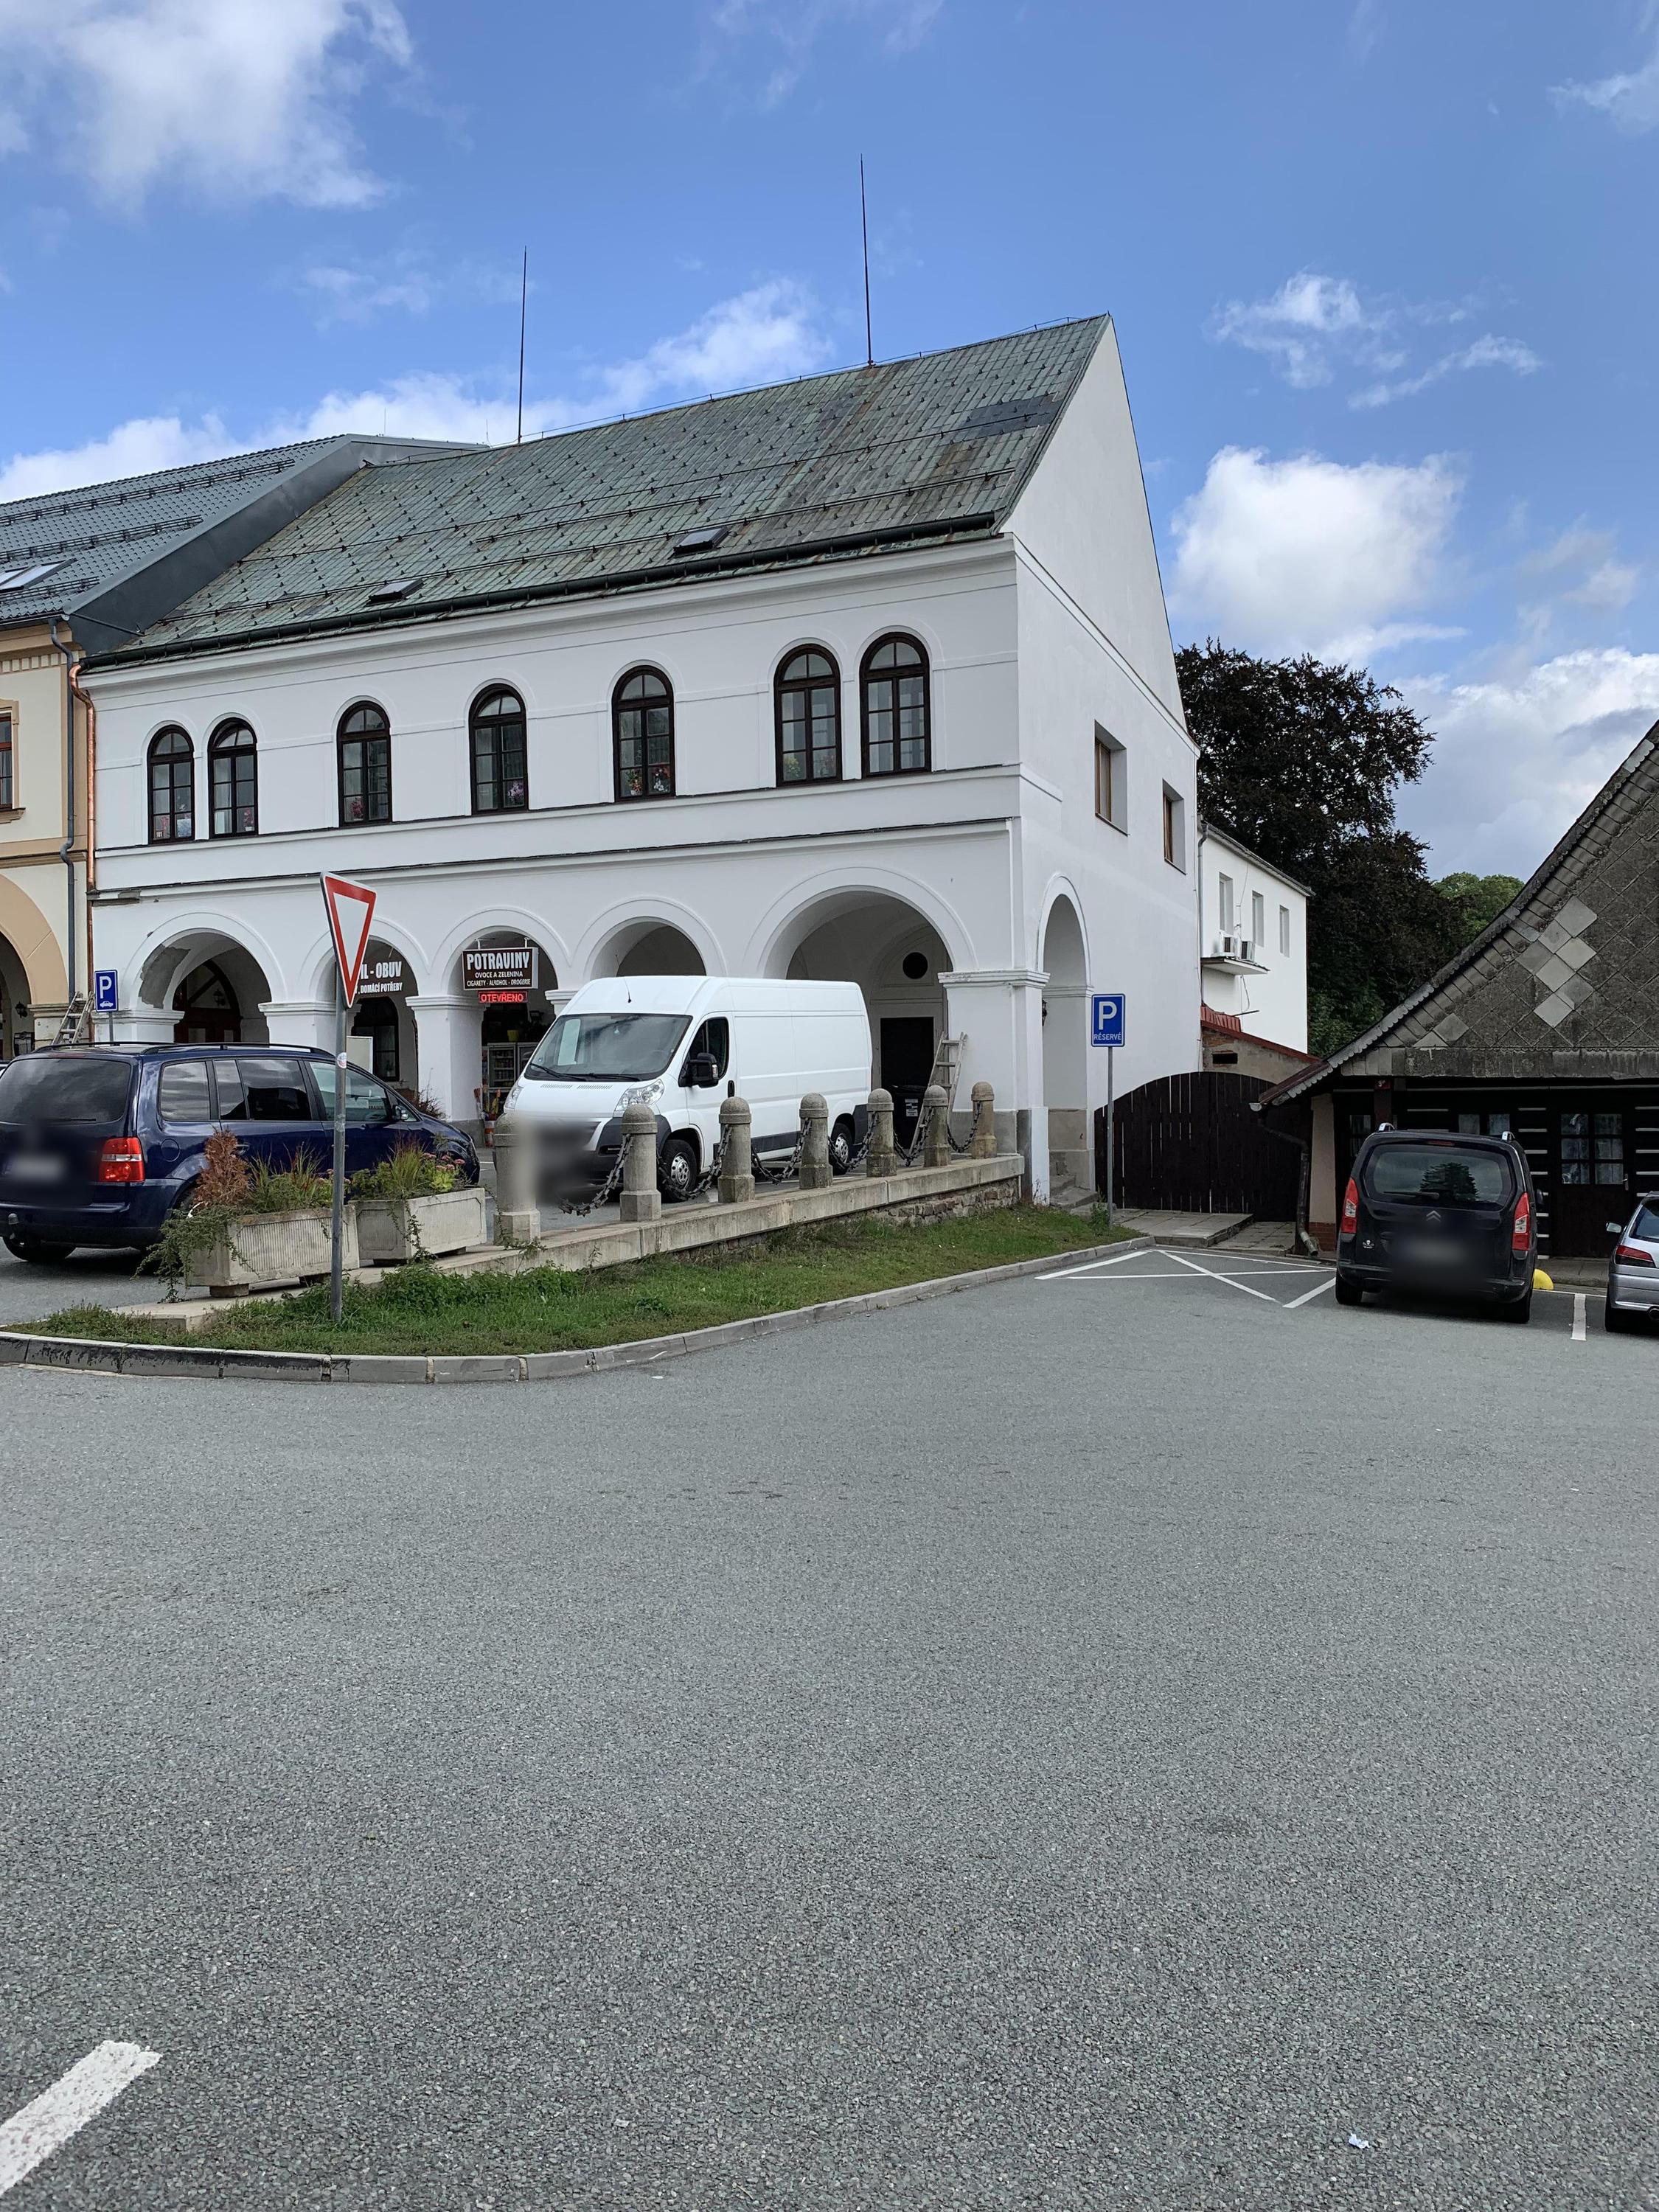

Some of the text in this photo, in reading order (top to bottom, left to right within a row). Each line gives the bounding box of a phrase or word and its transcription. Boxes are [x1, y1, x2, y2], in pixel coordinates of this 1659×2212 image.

[361, 964, 369, 979] IL
[375, 961, 402, 978] OBUV
[466, 952, 529, 970] POTRAVINY
[99, 975, 112, 999] P
[361, 982, 380, 994] DOMÁCÍ
[380, 981, 403, 992] POTŘEBY
[481, 992, 524, 1002] OTEVŘENO
[1099, 1001, 1117, 1030] P
[1093, 1032, 1121, 1040] RÉSERVÉ
